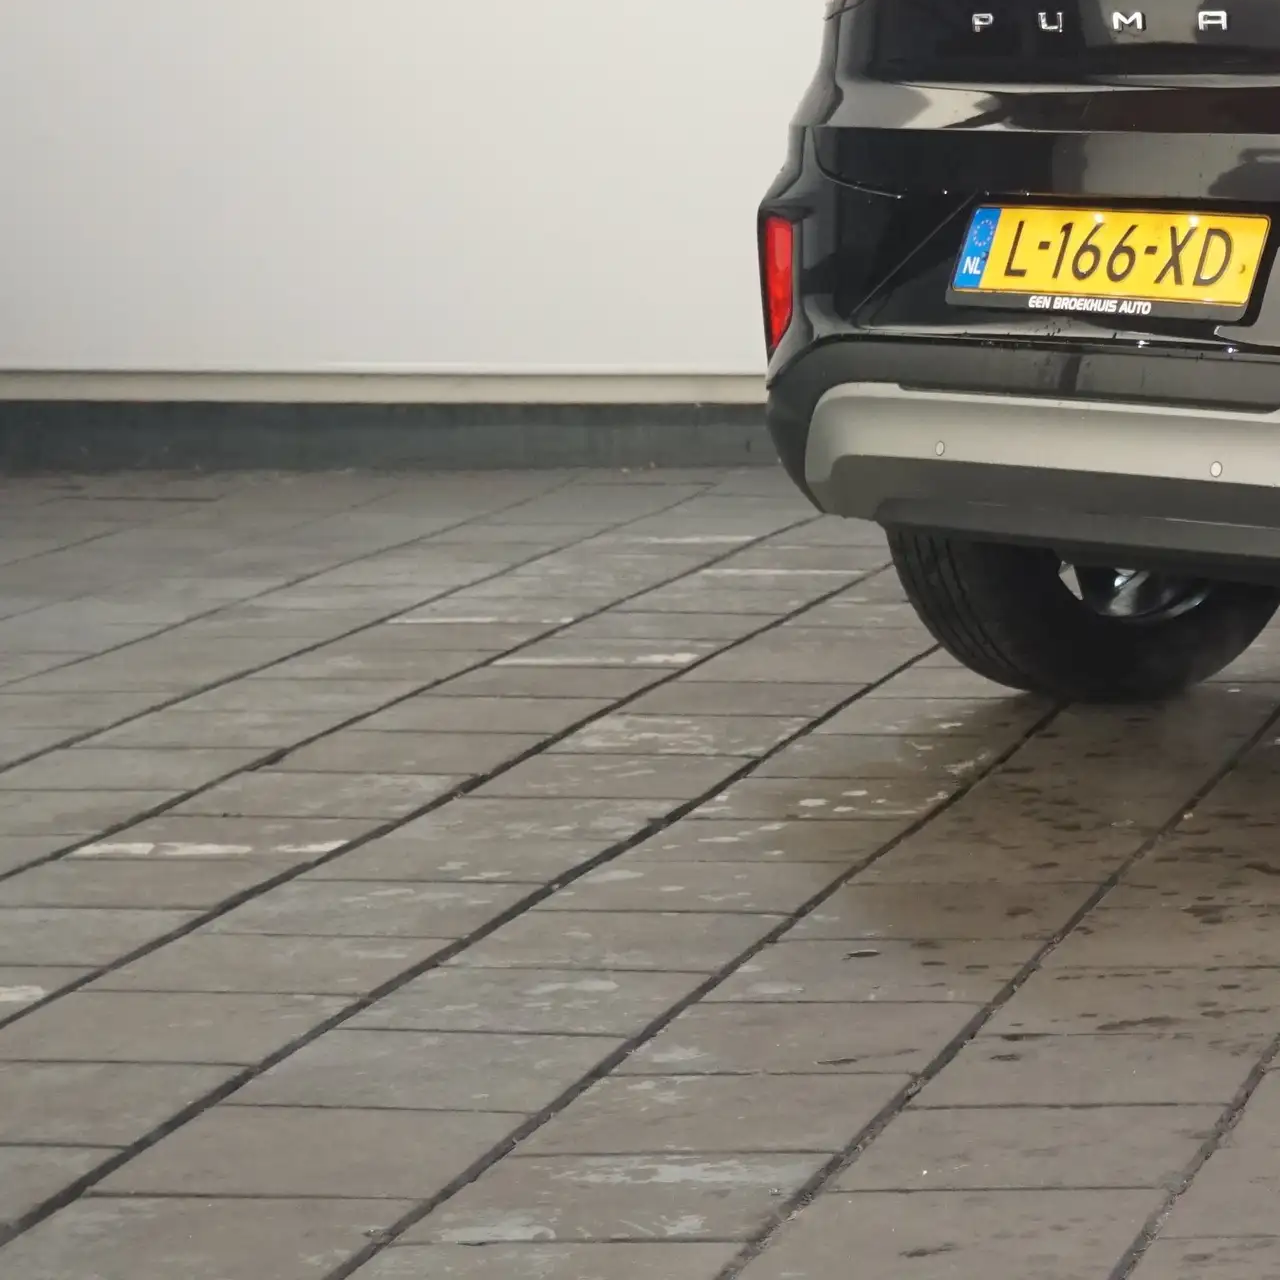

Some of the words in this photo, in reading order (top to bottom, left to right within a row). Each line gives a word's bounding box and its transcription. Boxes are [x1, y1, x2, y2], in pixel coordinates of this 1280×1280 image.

[971, 10, 1229, 34] PUMA
[1003, 219, 1234, 288] L-166-XD
[961, 255, 983, 276] NL
[1028, 295, 1052, 310] EEN
[1052, 297, 1118, 313] BROEKHUIS
[1118, 300, 1152, 315] AUTO
